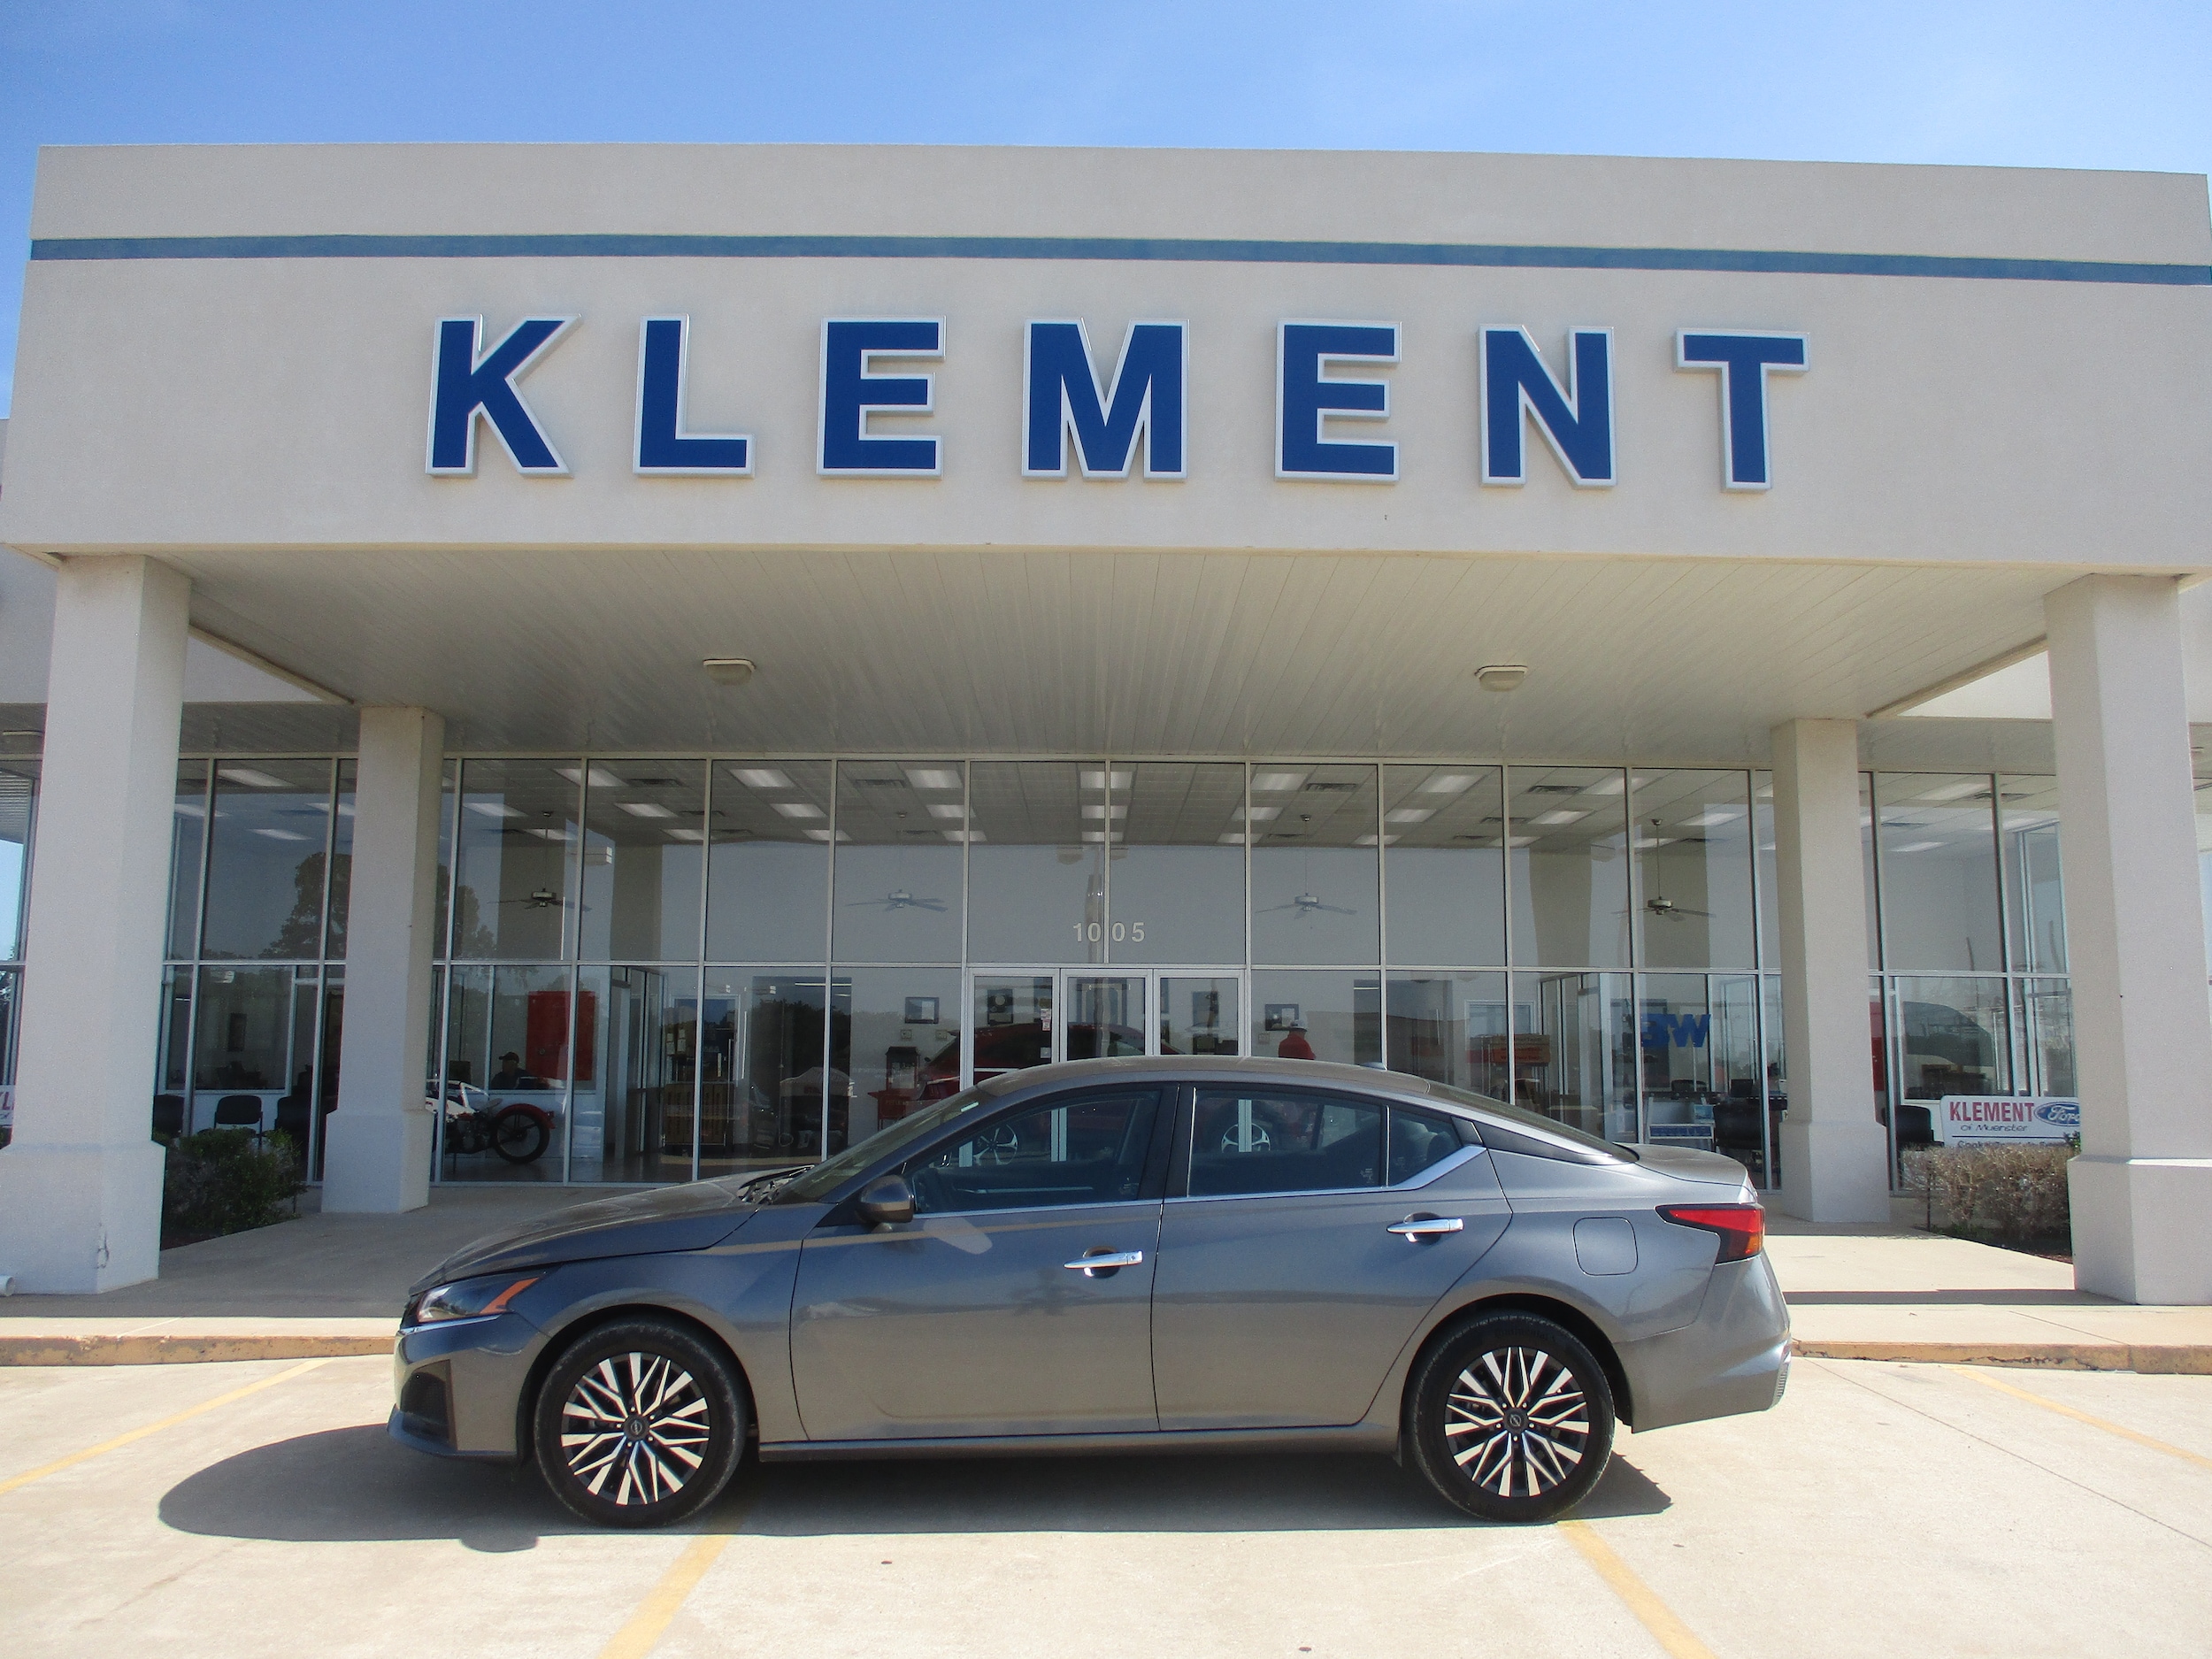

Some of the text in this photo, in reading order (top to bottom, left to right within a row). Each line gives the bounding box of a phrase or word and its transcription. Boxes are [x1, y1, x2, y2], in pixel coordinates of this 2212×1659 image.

[426, 313, 1810, 492] KLEMENT
[1072, 922, 1146, 942] 1005
[1949, 1102, 2034, 1122] KLEMENT
